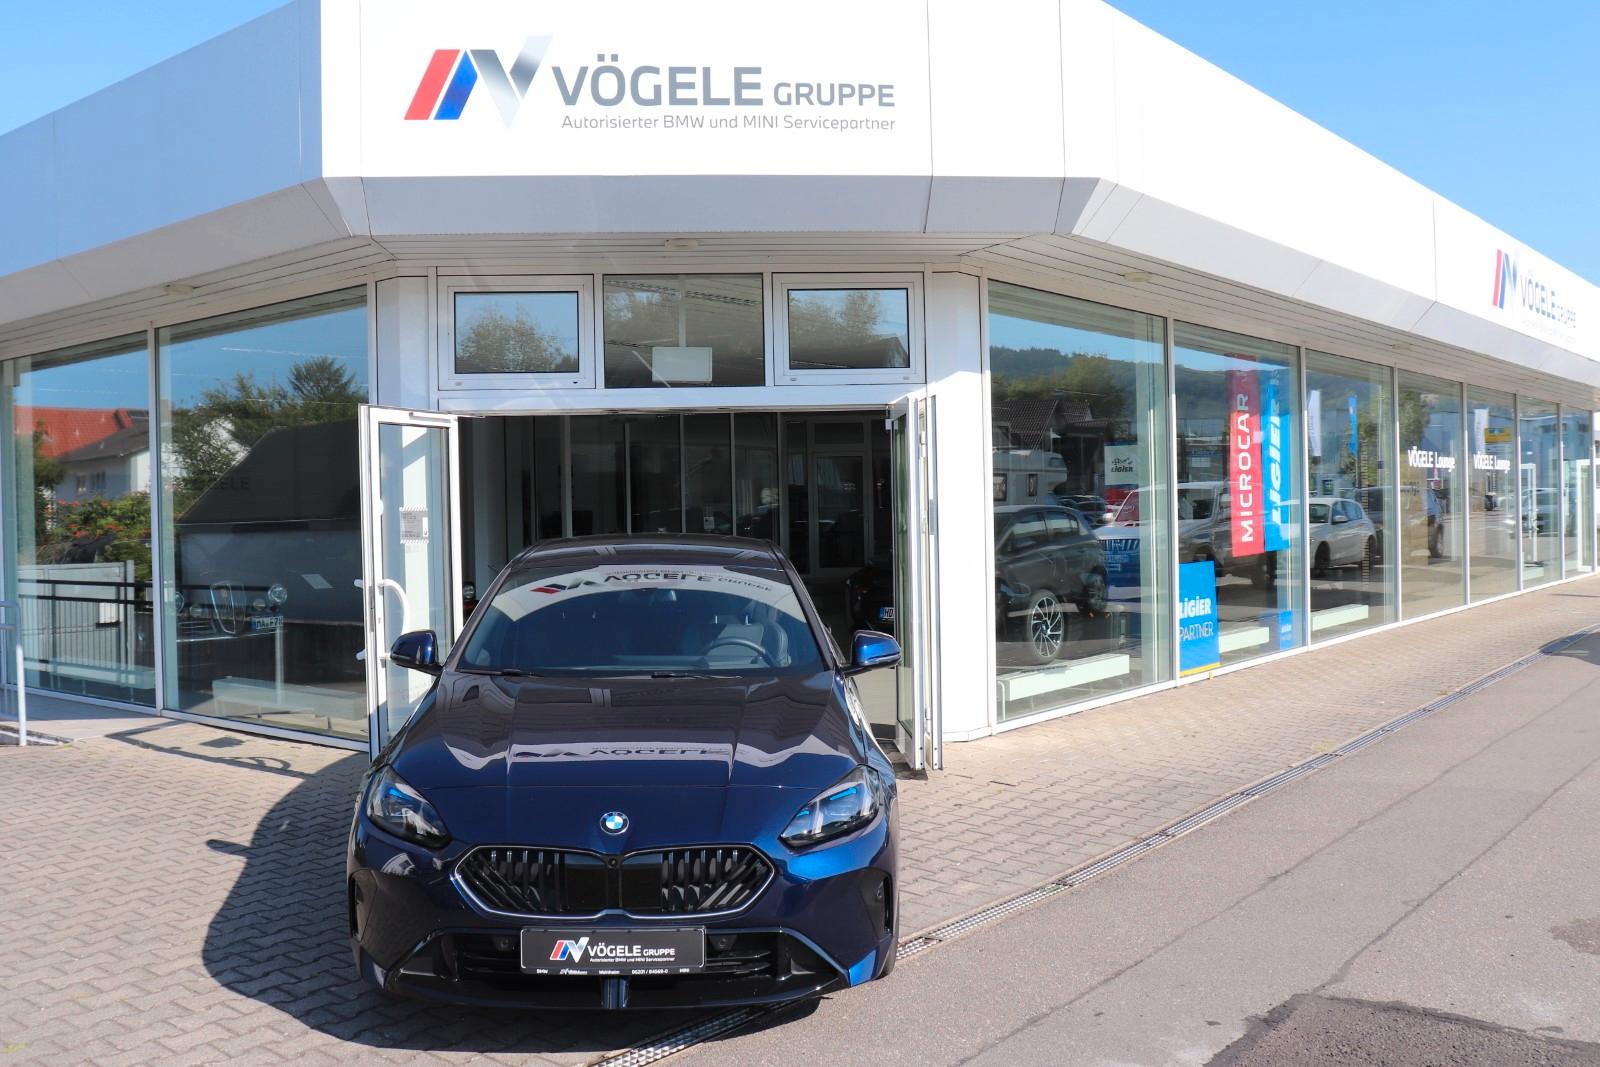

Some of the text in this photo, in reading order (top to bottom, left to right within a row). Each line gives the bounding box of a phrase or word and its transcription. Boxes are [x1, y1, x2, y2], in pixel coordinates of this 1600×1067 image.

[551, 53, 895, 107] VÖGELE GRUPPE
[562, 115, 896, 132] Autorisierter BMW und MINI Servicepartner
[1237, 393, 1255, 543] MICROCAR
[1179, 621, 1214, 641] PARTNER
[587, 942, 676, 957] VÖGELE GRUPPE
